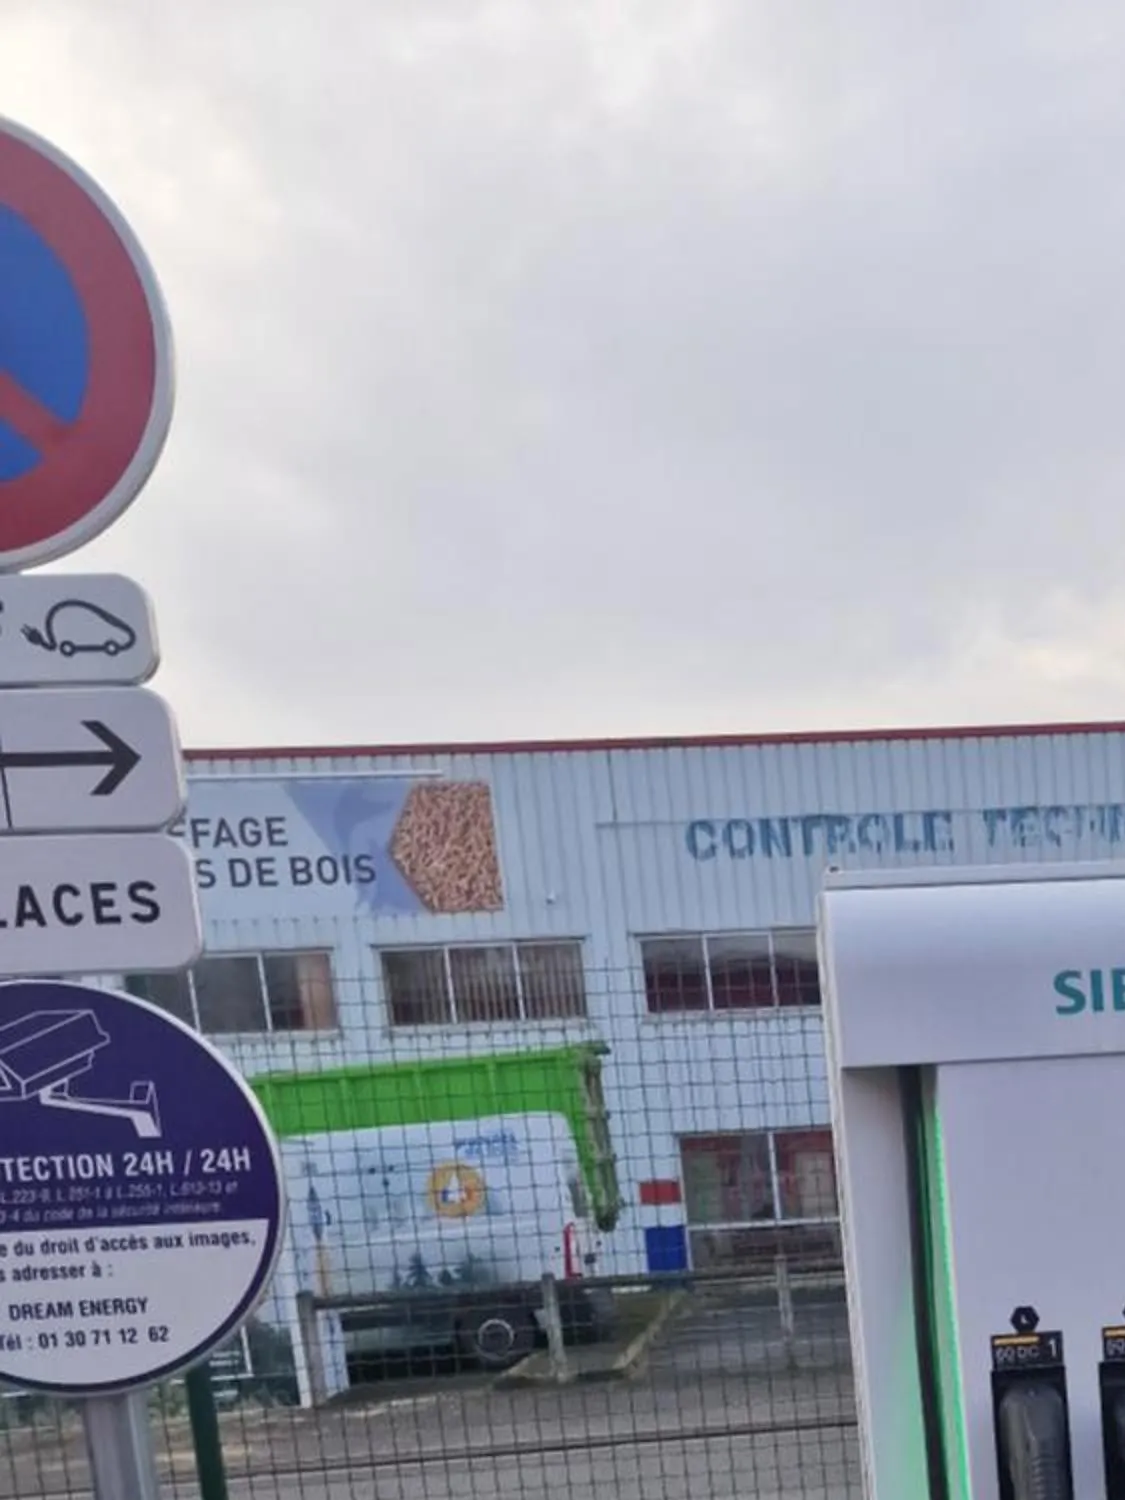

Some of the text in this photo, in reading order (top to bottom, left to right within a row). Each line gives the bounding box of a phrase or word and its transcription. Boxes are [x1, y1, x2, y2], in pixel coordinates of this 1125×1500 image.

[168, 816, 289, 849] FAGE
[685, 810, 953, 861] CONTROLE
[228, 858, 279, 889] DE
[288, 854, 376, 887] BOIS
[0, 1153, 114, 1182] TECTION
[122, 1150, 175, 1177] 24H
[200, 1146, 251, 1172] 24H
[14, 1240, 35, 1257] du
[40, 1237, 80, 1255] droit
[153, 1234, 183, 1249] aux
[12, 1265, 86, 1282] adresser
[8, 1297, 148, 1321] DREAM ENERGY
[38, 1332, 58, 1349] 01
[65, 1330, 86, 1348] 30
[91, 1328, 111, 1345] 71
[118, 1327, 138, 1344] 12
[148, 1325, 170, 1343] 62
[1048, 1338, 1057, 1358] 1
